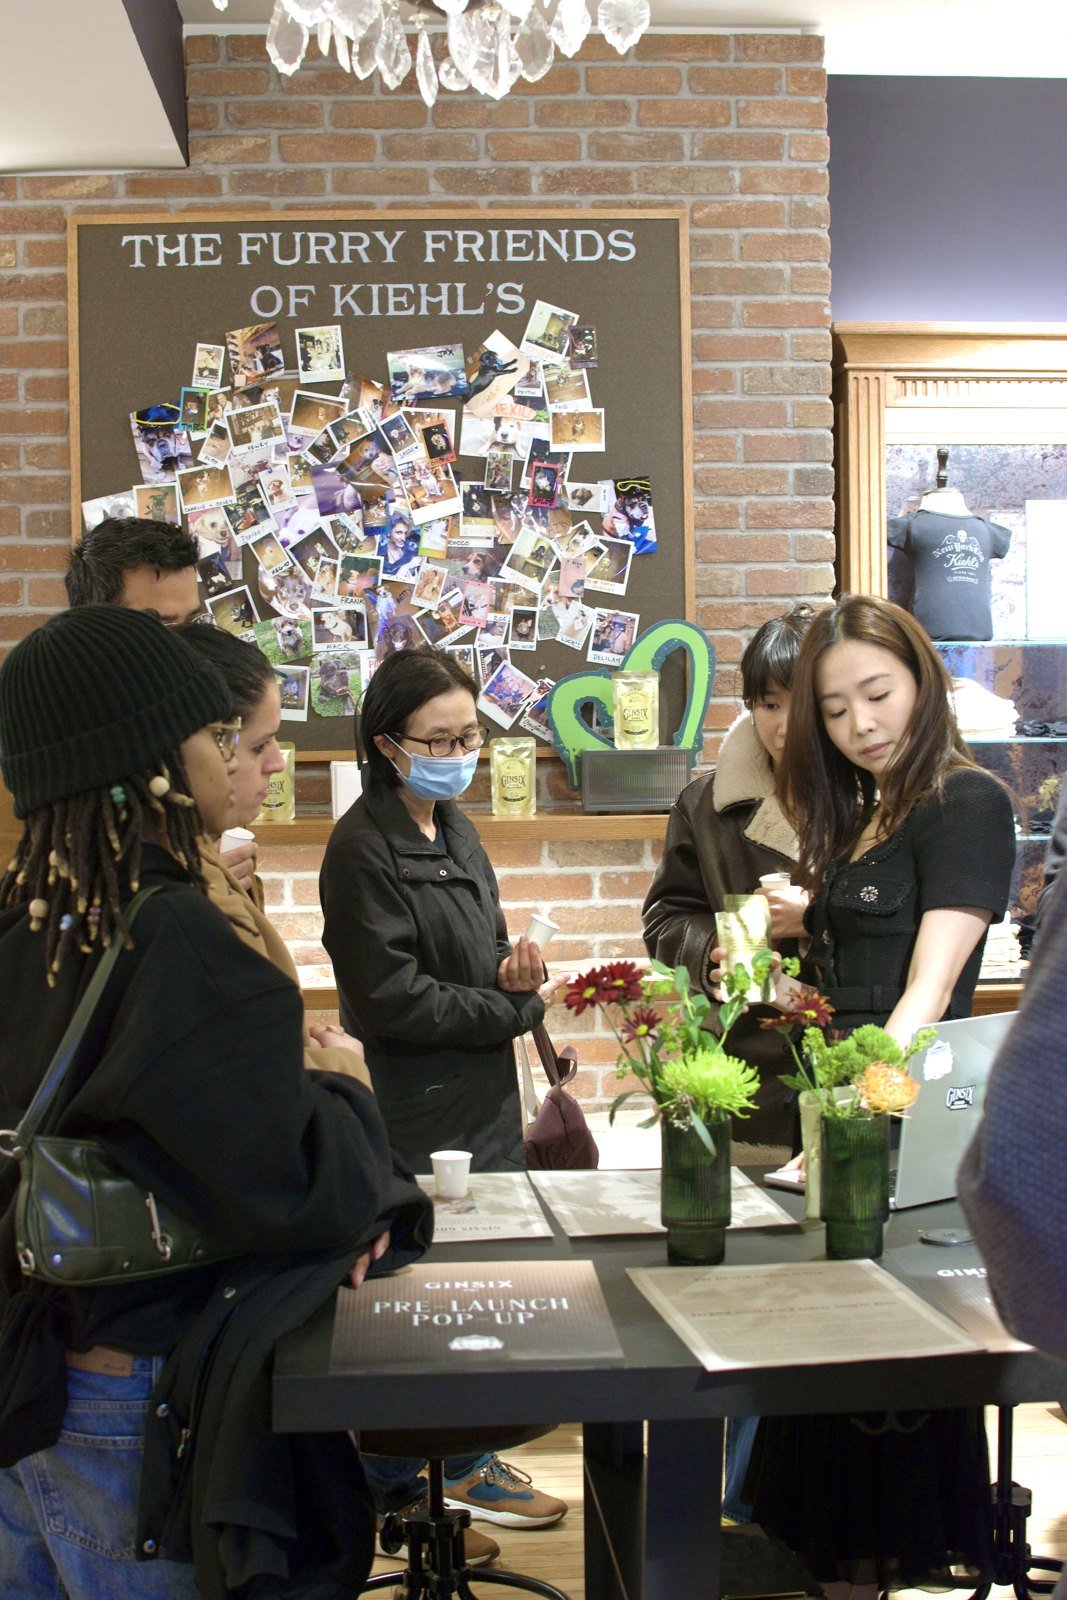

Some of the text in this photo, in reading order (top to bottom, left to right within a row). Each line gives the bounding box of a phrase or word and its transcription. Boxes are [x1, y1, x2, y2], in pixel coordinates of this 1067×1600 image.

[121, 229, 637, 268] THE FURRY FRIENDS
[250, 281, 526, 318] OF KIEHL'S
[448, 539, 470, 547] ROCCO
[340, 596, 365, 605] FRANK
[501, 774, 527, 788] GINSIX
[946, 1085, 975, 1107] GINSIX
[936, 1267, 988, 1277] GINS
[423, 1280, 514, 1290] GINSIX
[373, 1297, 570, 1314] PRE-LAUNCH
[412, 1311, 535, 1327] POP-UP
